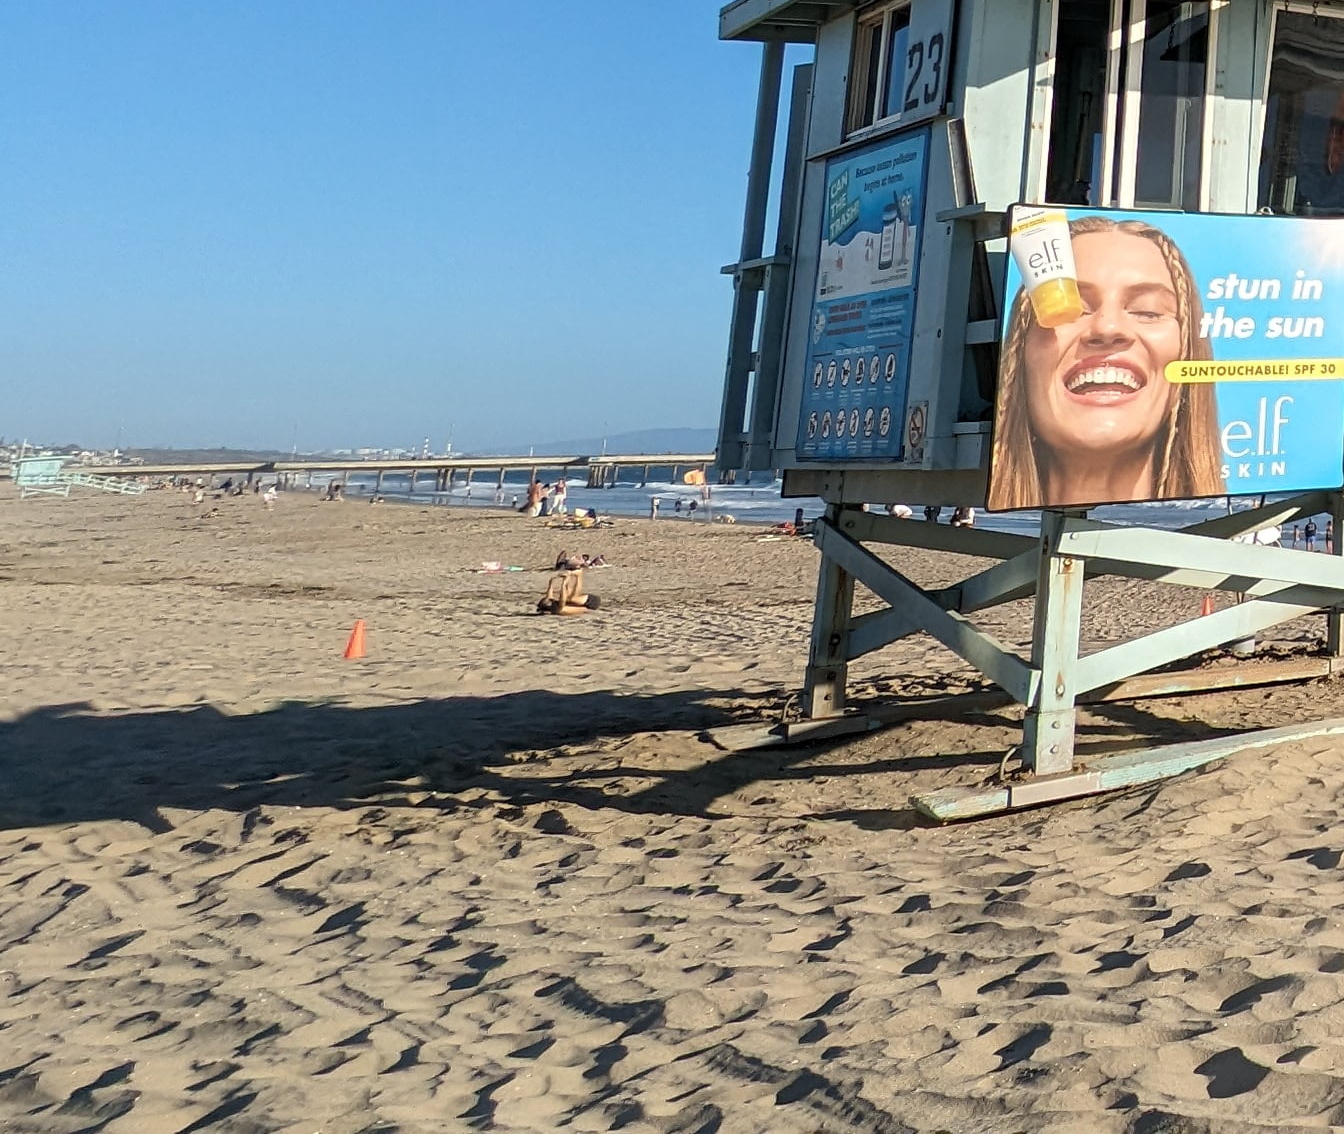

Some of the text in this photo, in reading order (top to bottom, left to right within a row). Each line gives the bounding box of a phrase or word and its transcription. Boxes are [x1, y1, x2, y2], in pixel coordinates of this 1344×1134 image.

[904, 32, 944, 112] 23
[830, 171, 848, 199] CAN
[830, 192, 847, 218] THE
[1034, 264, 1064, 278] SKIN
[1206, 270, 1323, 300] stun in
[1199, 306, 1325, 338] the sun
[1180, 364, 1336, 377] SUNTOUCHABLE! SPF 30
[1219, 461, 1287, 479] SKIN
